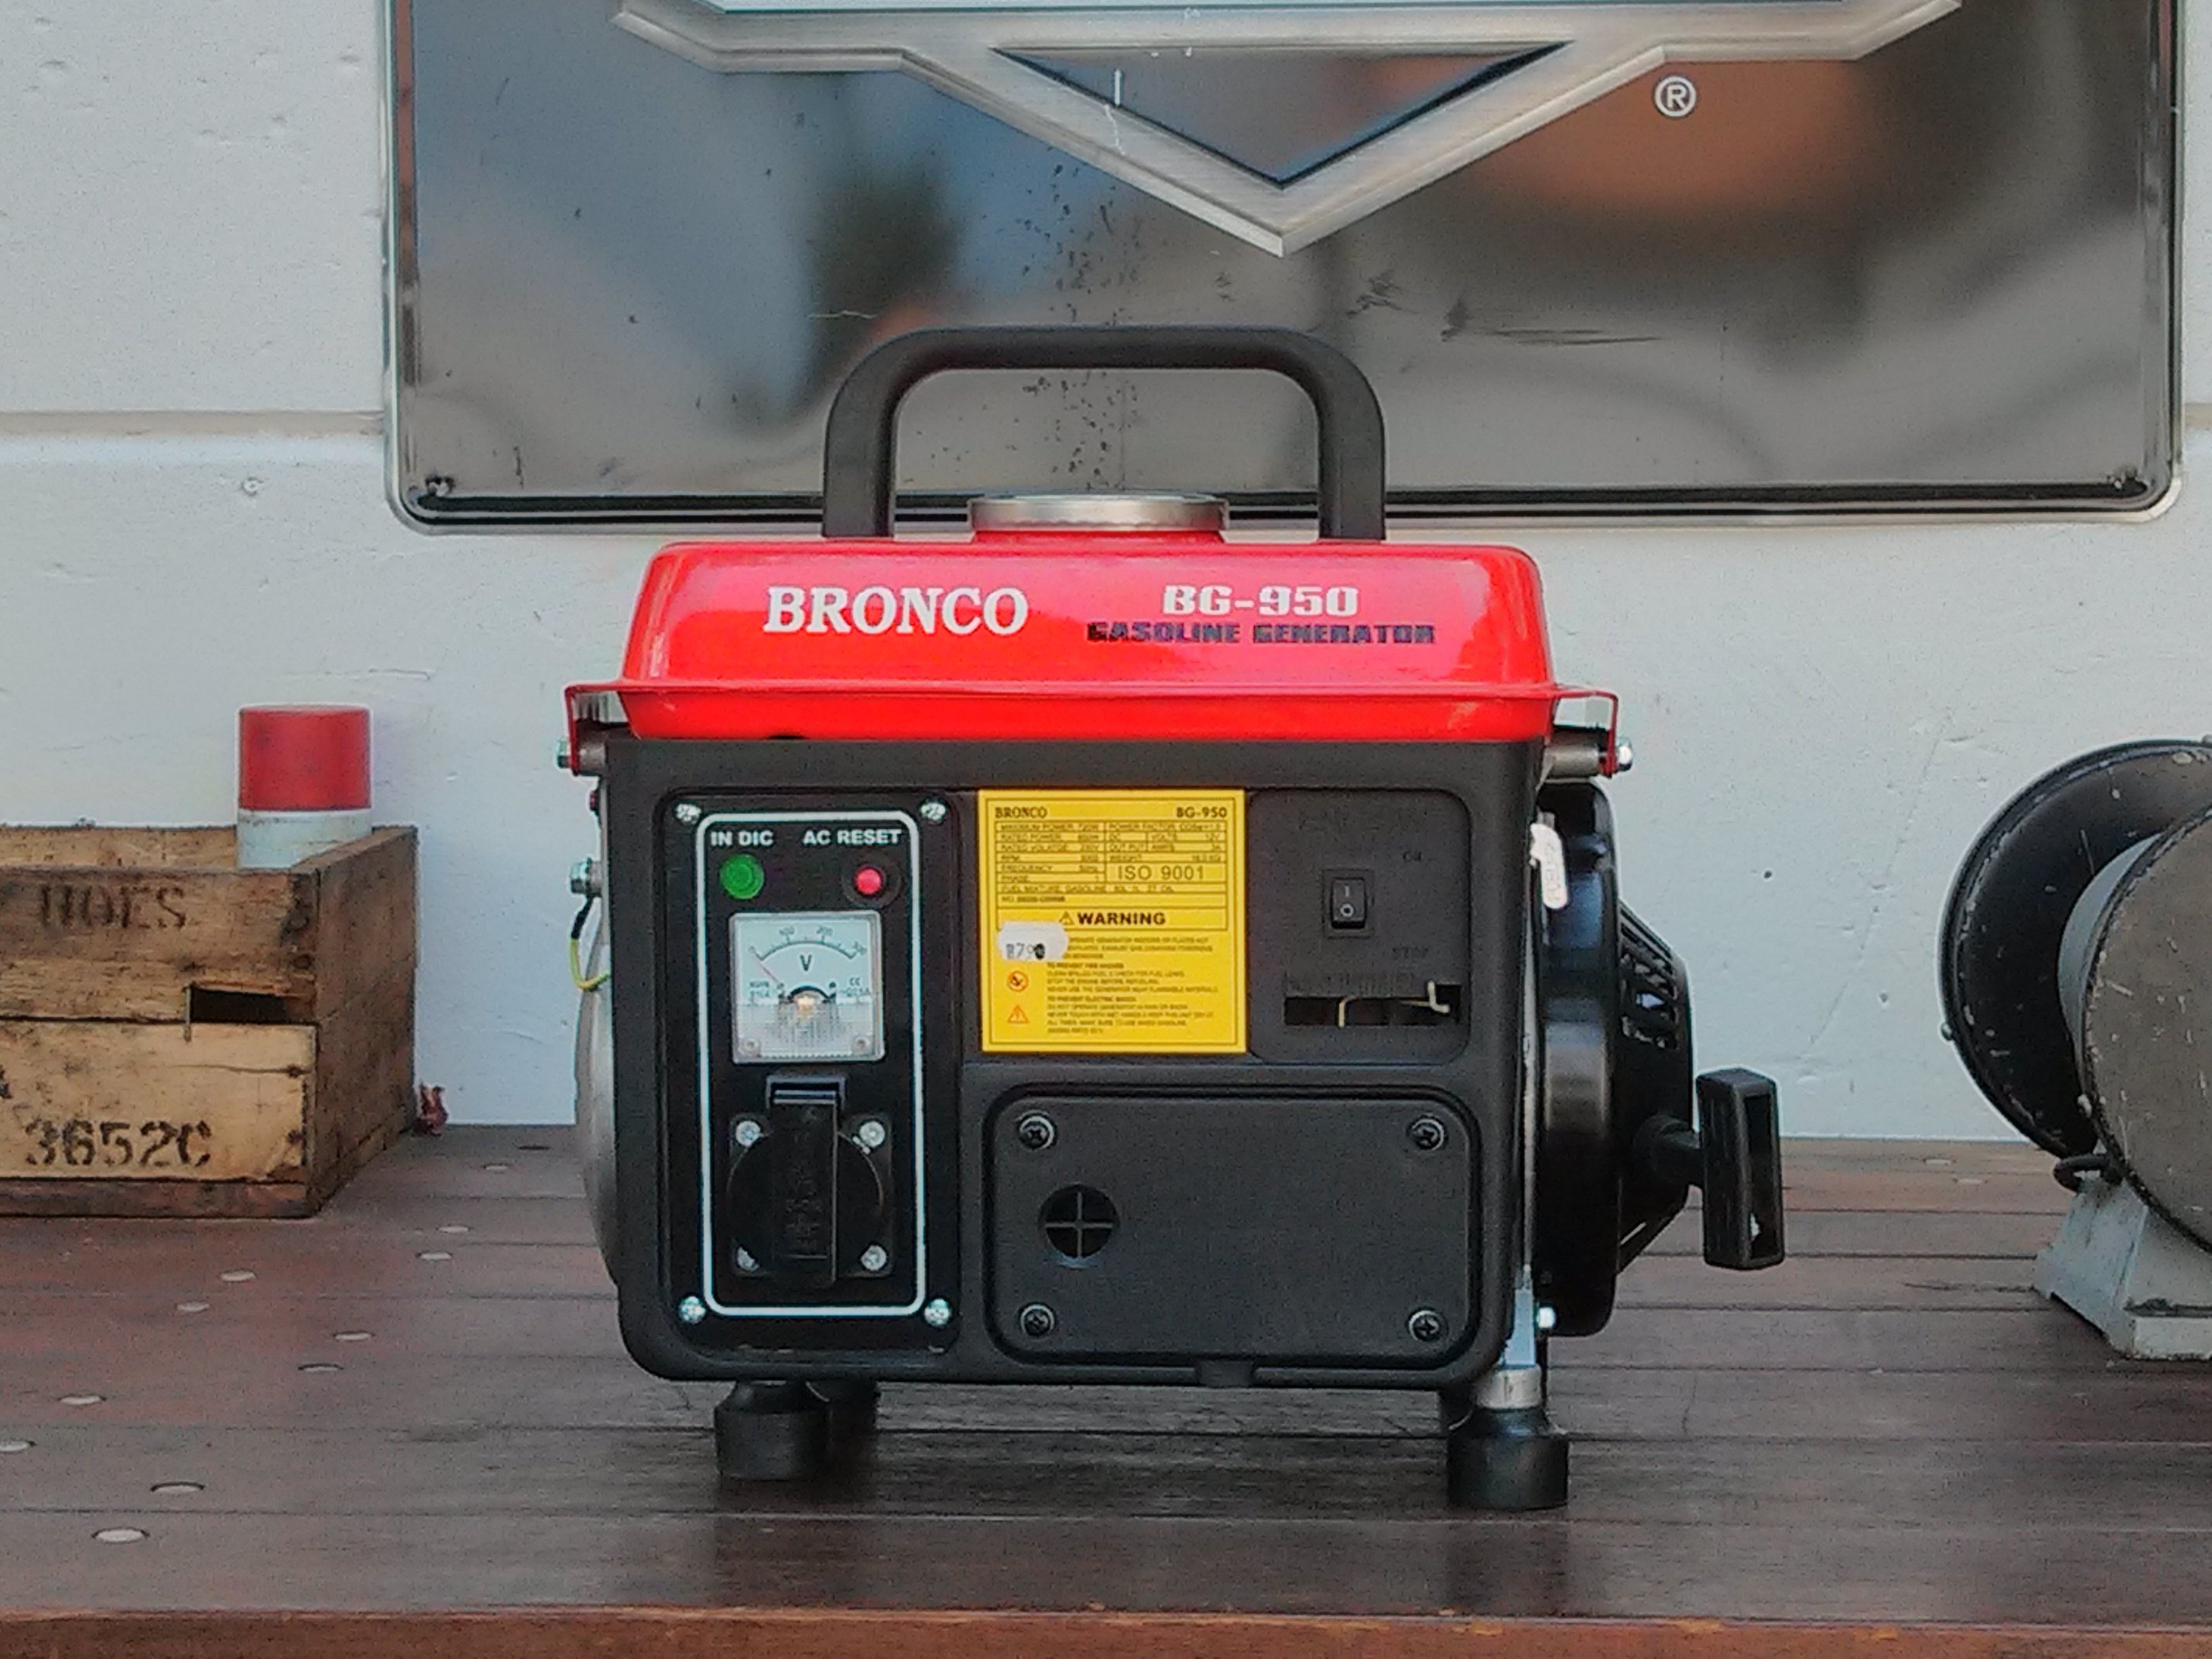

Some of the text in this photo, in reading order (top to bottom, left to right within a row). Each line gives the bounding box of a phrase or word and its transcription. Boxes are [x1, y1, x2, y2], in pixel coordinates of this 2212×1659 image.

[1162, 585, 1359, 617] BG-950
[762, 586, 1029, 636] BRONCO
[1086, 621, 1436, 644] GASOLINE GENERATOR
[994, 806, 1048, 819] BRONCO
[1176, 806, 1228, 819] BG-950
[711, 830, 774, 846] IN DIC
[802, 828, 902, 844] AC RESET
[1118, 865, 1204, 880] ISO 9001
[1078, 912, 1166, 926] WARNING
[800, 954, 813, 971] V
